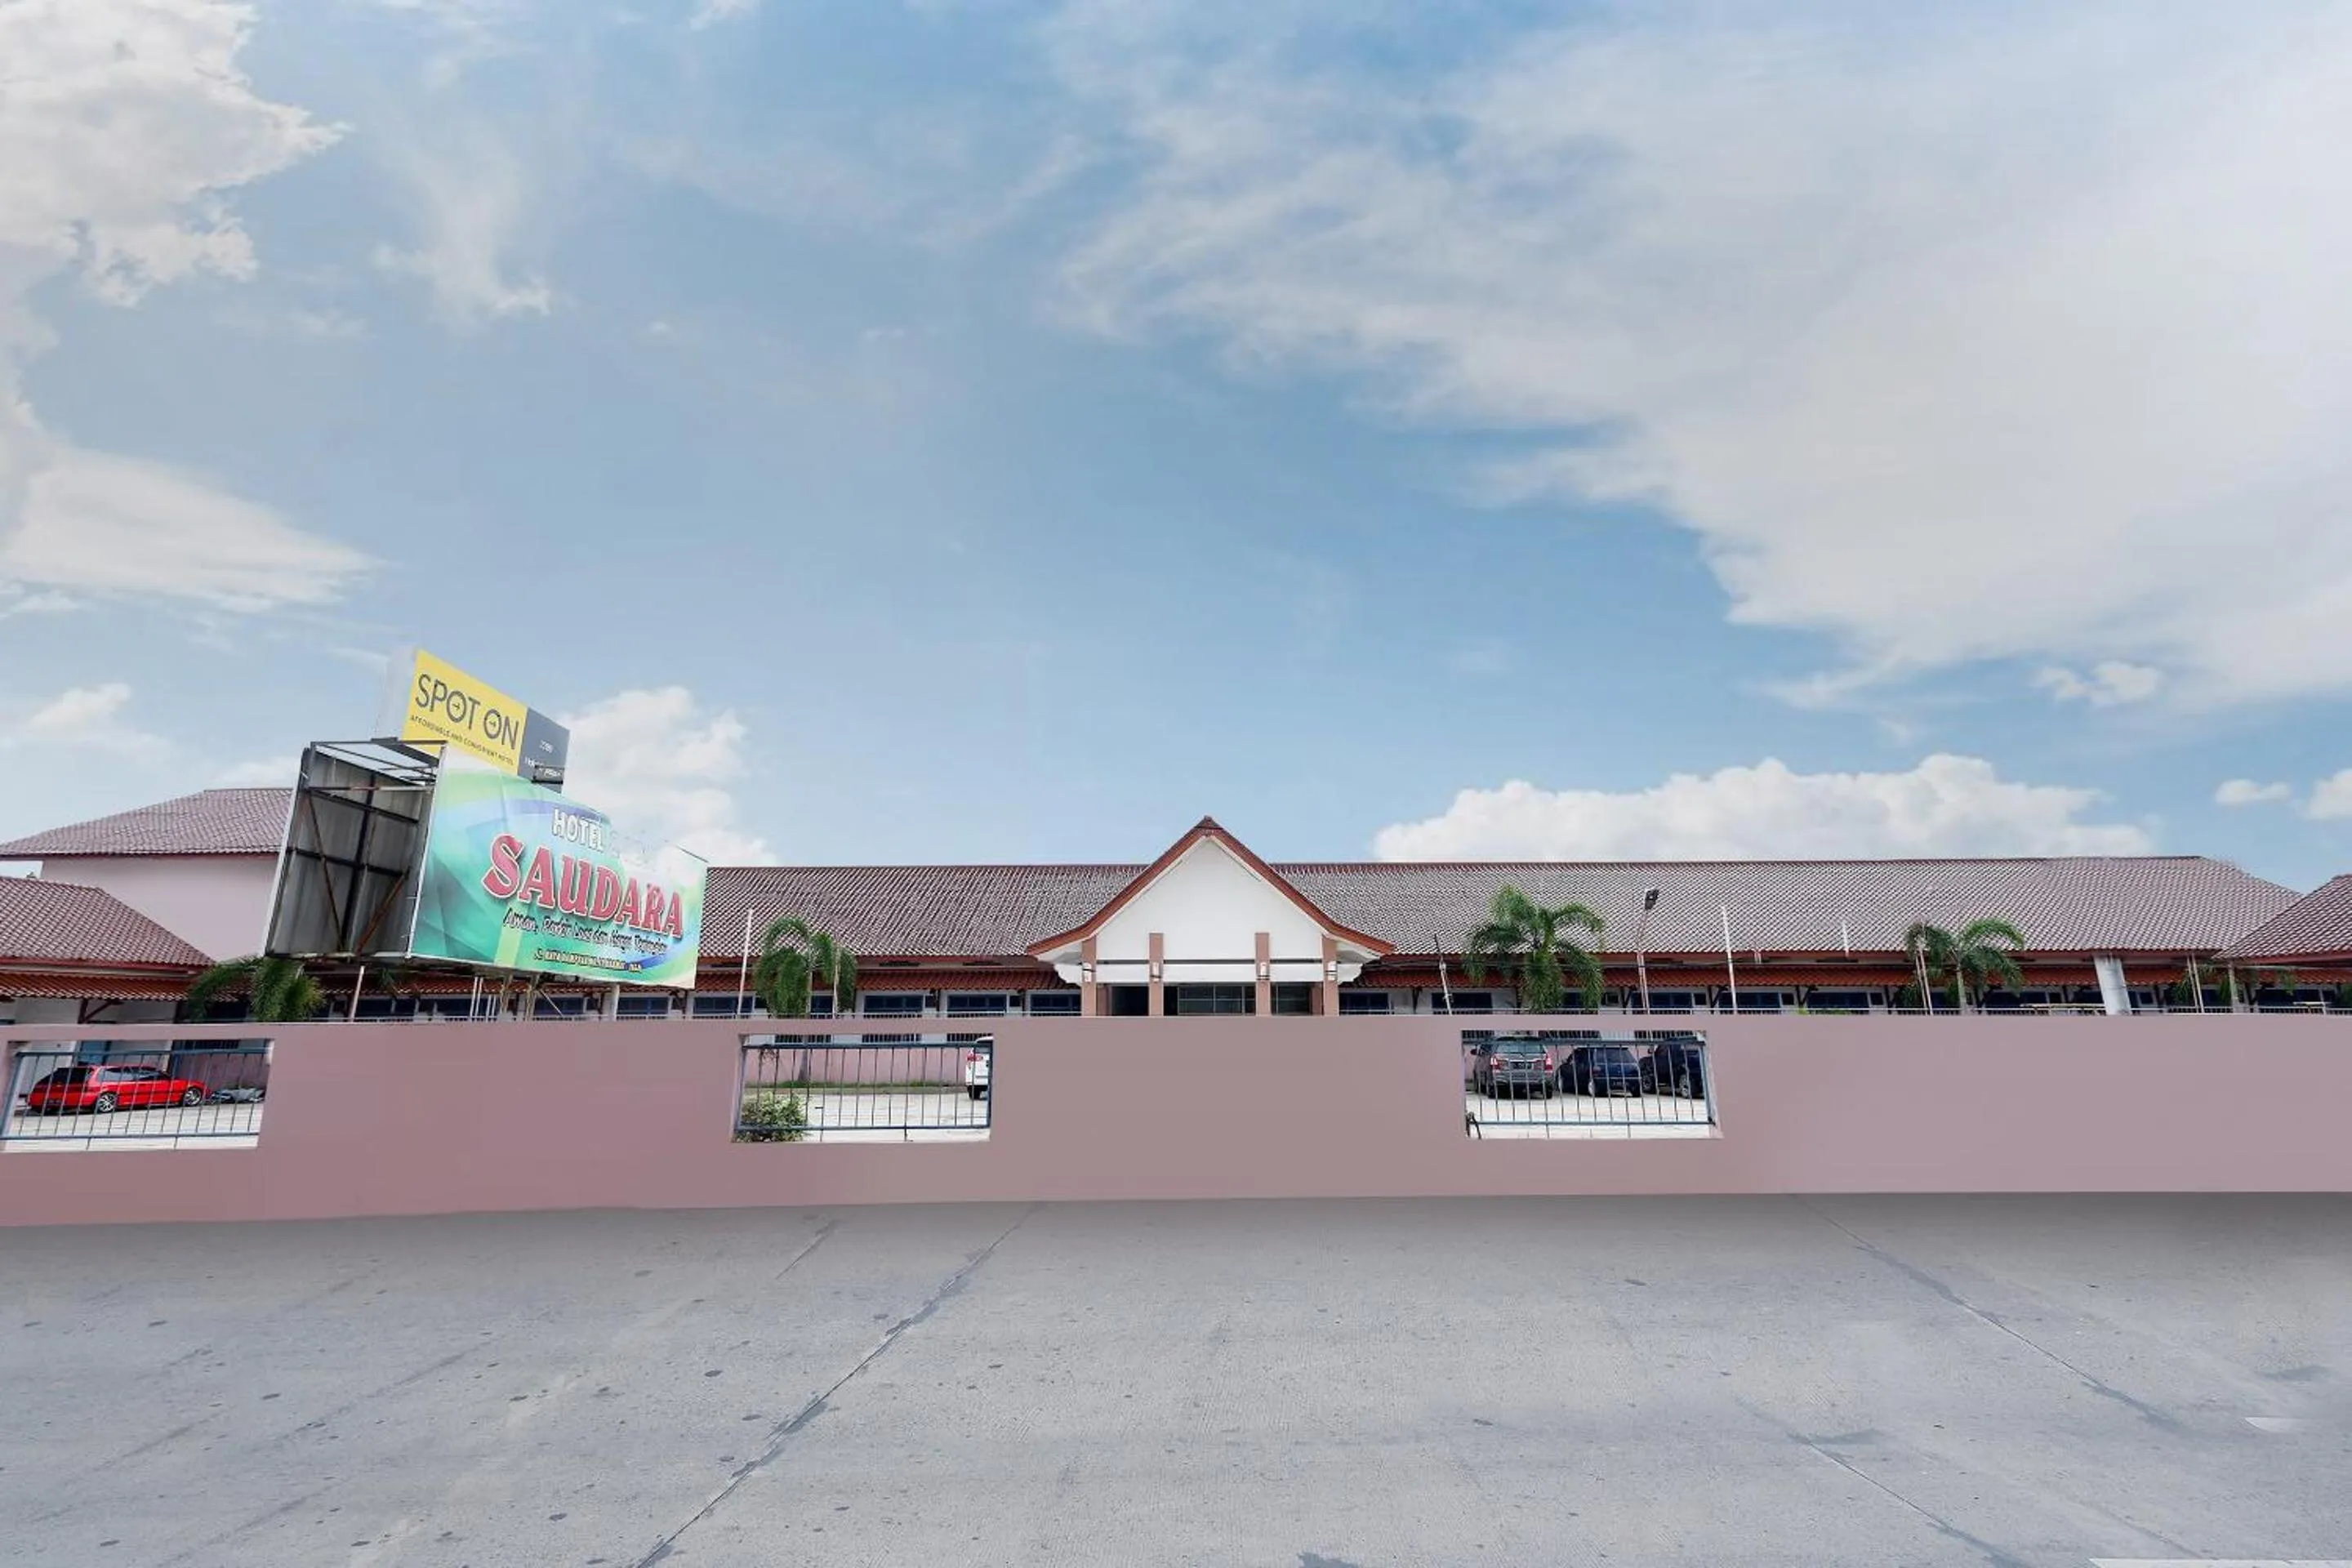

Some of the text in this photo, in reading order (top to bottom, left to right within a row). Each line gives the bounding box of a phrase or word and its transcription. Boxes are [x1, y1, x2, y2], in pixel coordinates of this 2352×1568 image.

[415, 673, 519, 750] SPOT ON
[552, 807, 604, 853] HOTEL
[481, 833, 684, 938] SAUDARA
